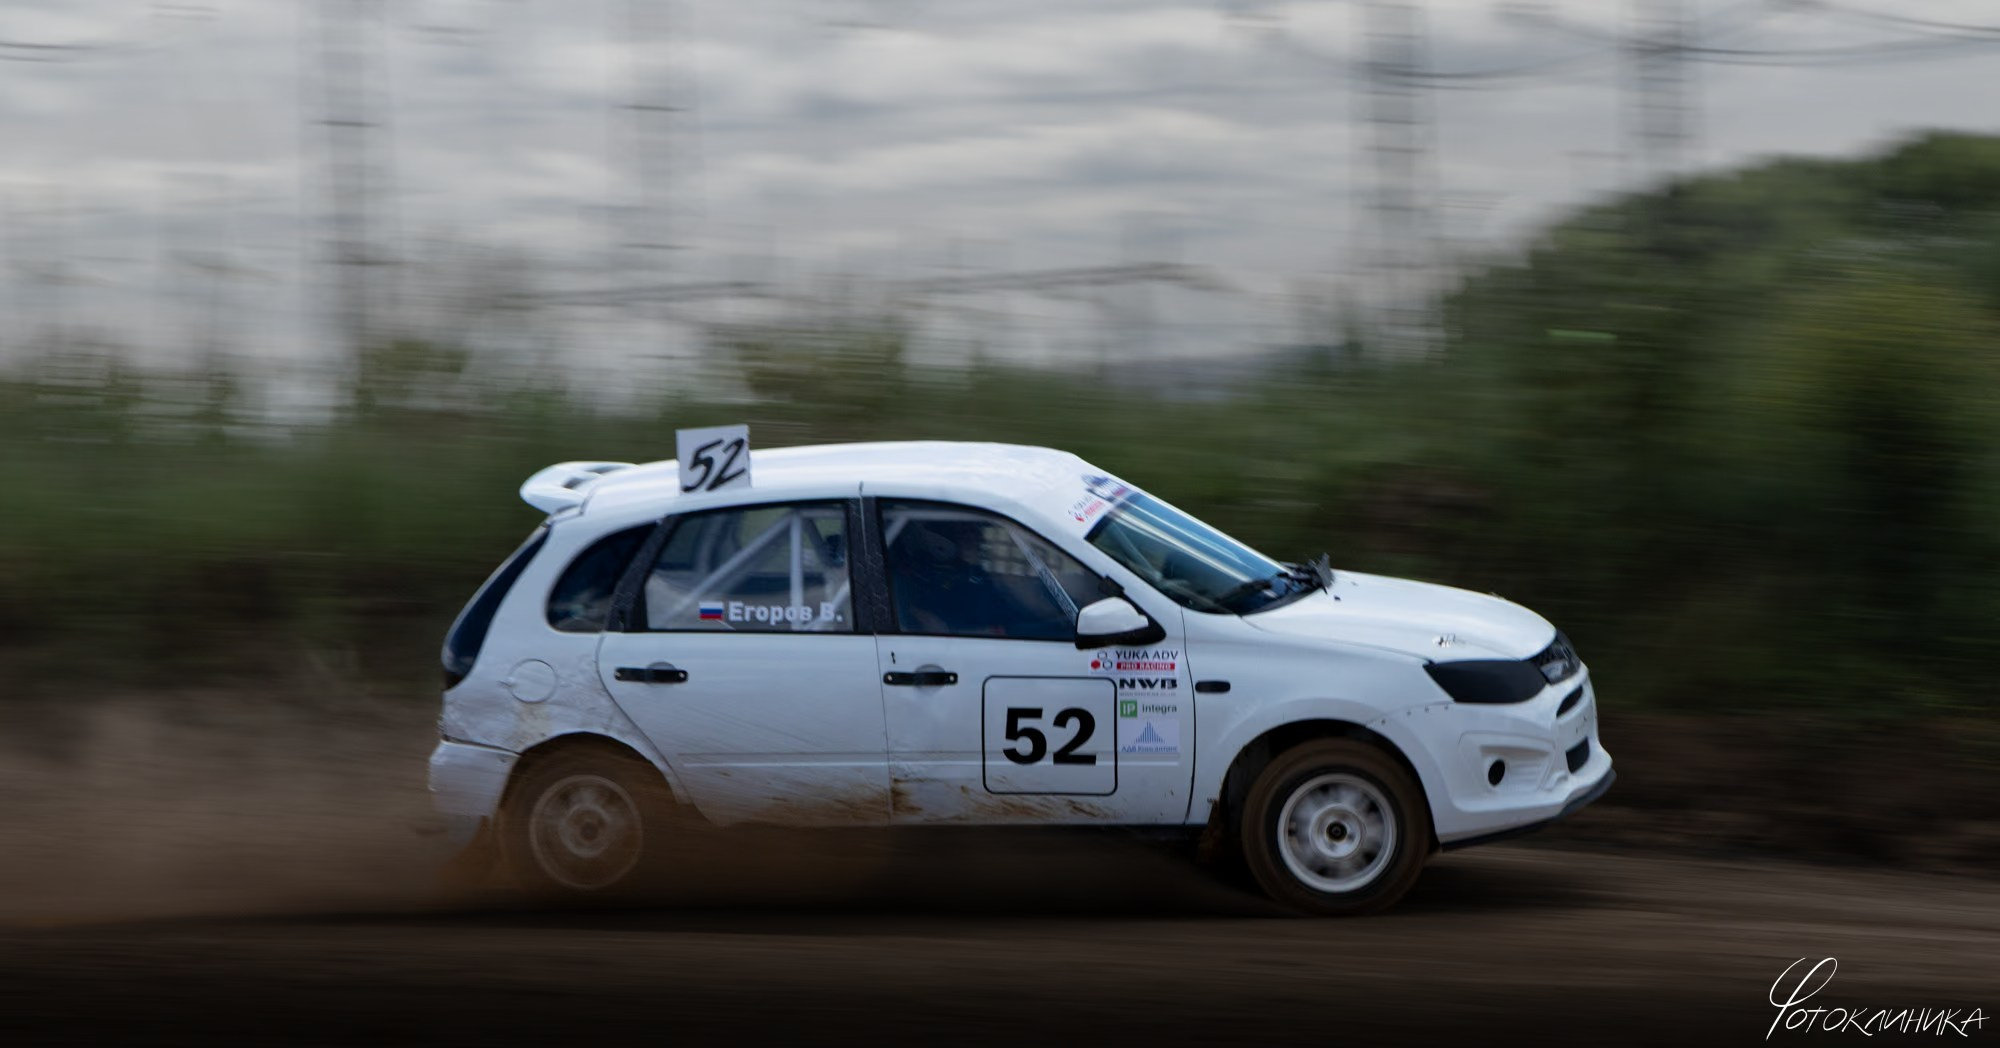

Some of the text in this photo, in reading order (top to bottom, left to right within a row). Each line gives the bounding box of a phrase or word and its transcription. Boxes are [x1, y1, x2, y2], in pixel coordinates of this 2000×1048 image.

[681, 438, 746, 492] 52
[728, 601, 843, 626] Егоров В.
[1115, 650, 1179, 660] YUKA ADV
[1119, 678, 1178, 689] NWB
[1142, 704, 1178, 715] integra
[1003, 707, 1097, 766] 52
